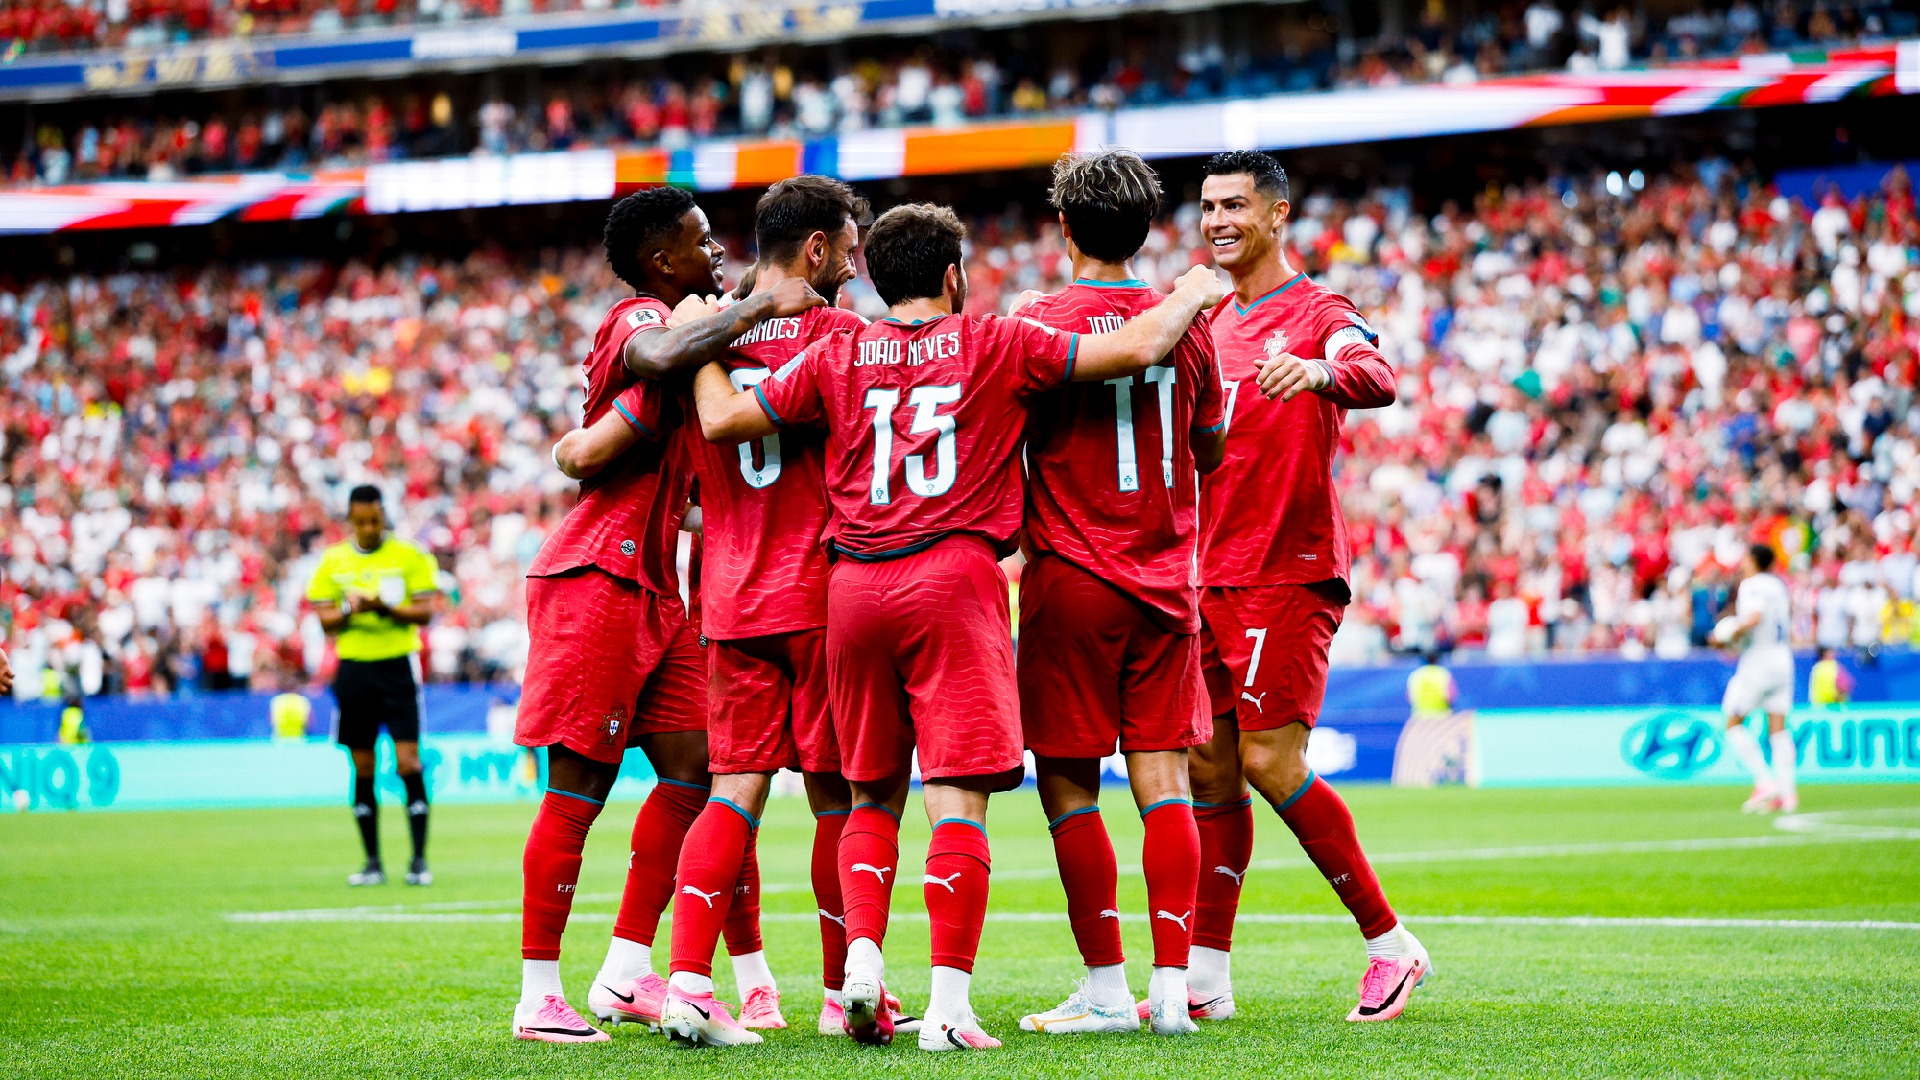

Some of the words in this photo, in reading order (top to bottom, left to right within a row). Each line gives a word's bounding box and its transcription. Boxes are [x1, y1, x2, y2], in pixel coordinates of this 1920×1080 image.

[853, 336, 901, 367] JOÃO
[906, 331, 960, 366] NEVES
[1104, 366, 1176, 492] 11
[1222, 379, 1241, 436] 7
[864, 381, 962, 505] 15
[1243, 627, 1268, 687] 7
